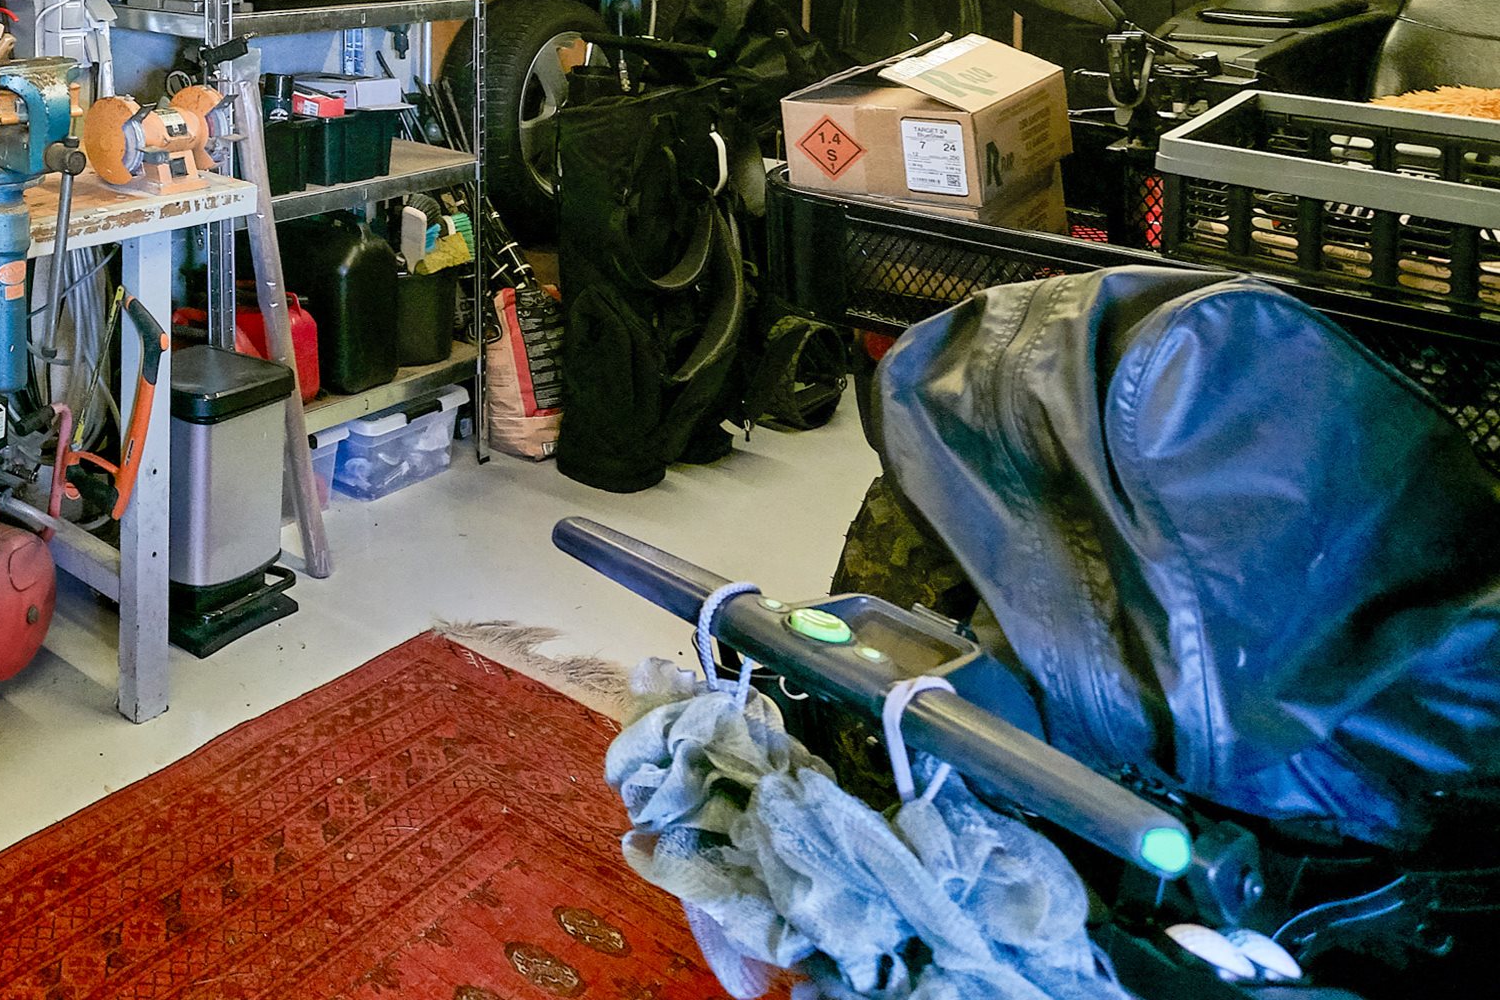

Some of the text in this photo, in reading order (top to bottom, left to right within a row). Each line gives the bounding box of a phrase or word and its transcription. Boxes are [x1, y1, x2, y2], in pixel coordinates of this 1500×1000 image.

[818, 131, 842, 145] 1.4
[919, 140, 957, 152] 7 24
[826, 148, 838, 162] S
